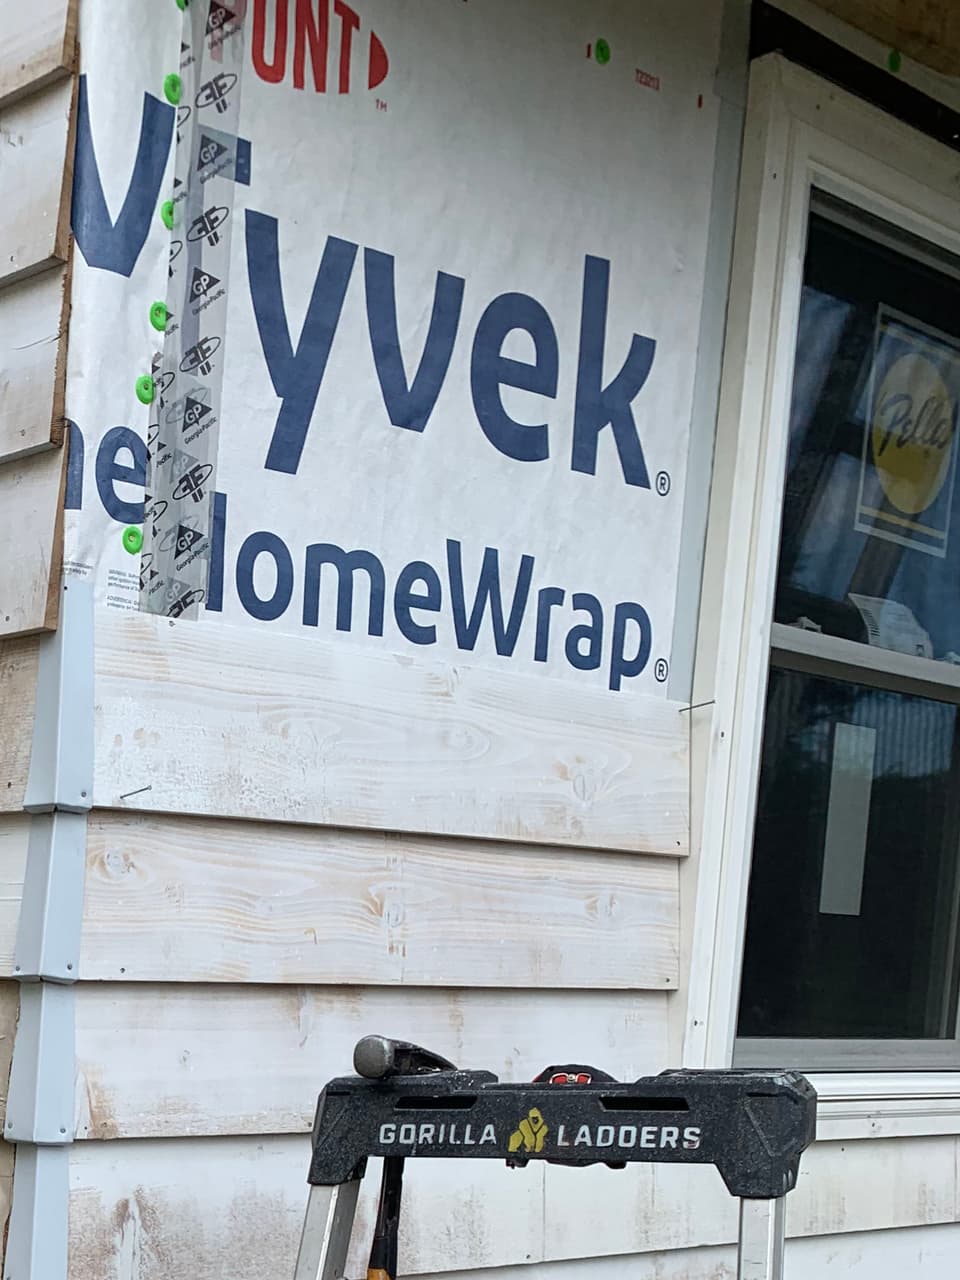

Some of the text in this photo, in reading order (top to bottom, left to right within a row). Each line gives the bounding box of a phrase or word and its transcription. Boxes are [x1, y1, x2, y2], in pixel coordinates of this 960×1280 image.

[878, 391, 950, 457] Pella
[378, 1122, 702, 1150] GORILLA LADDERS
